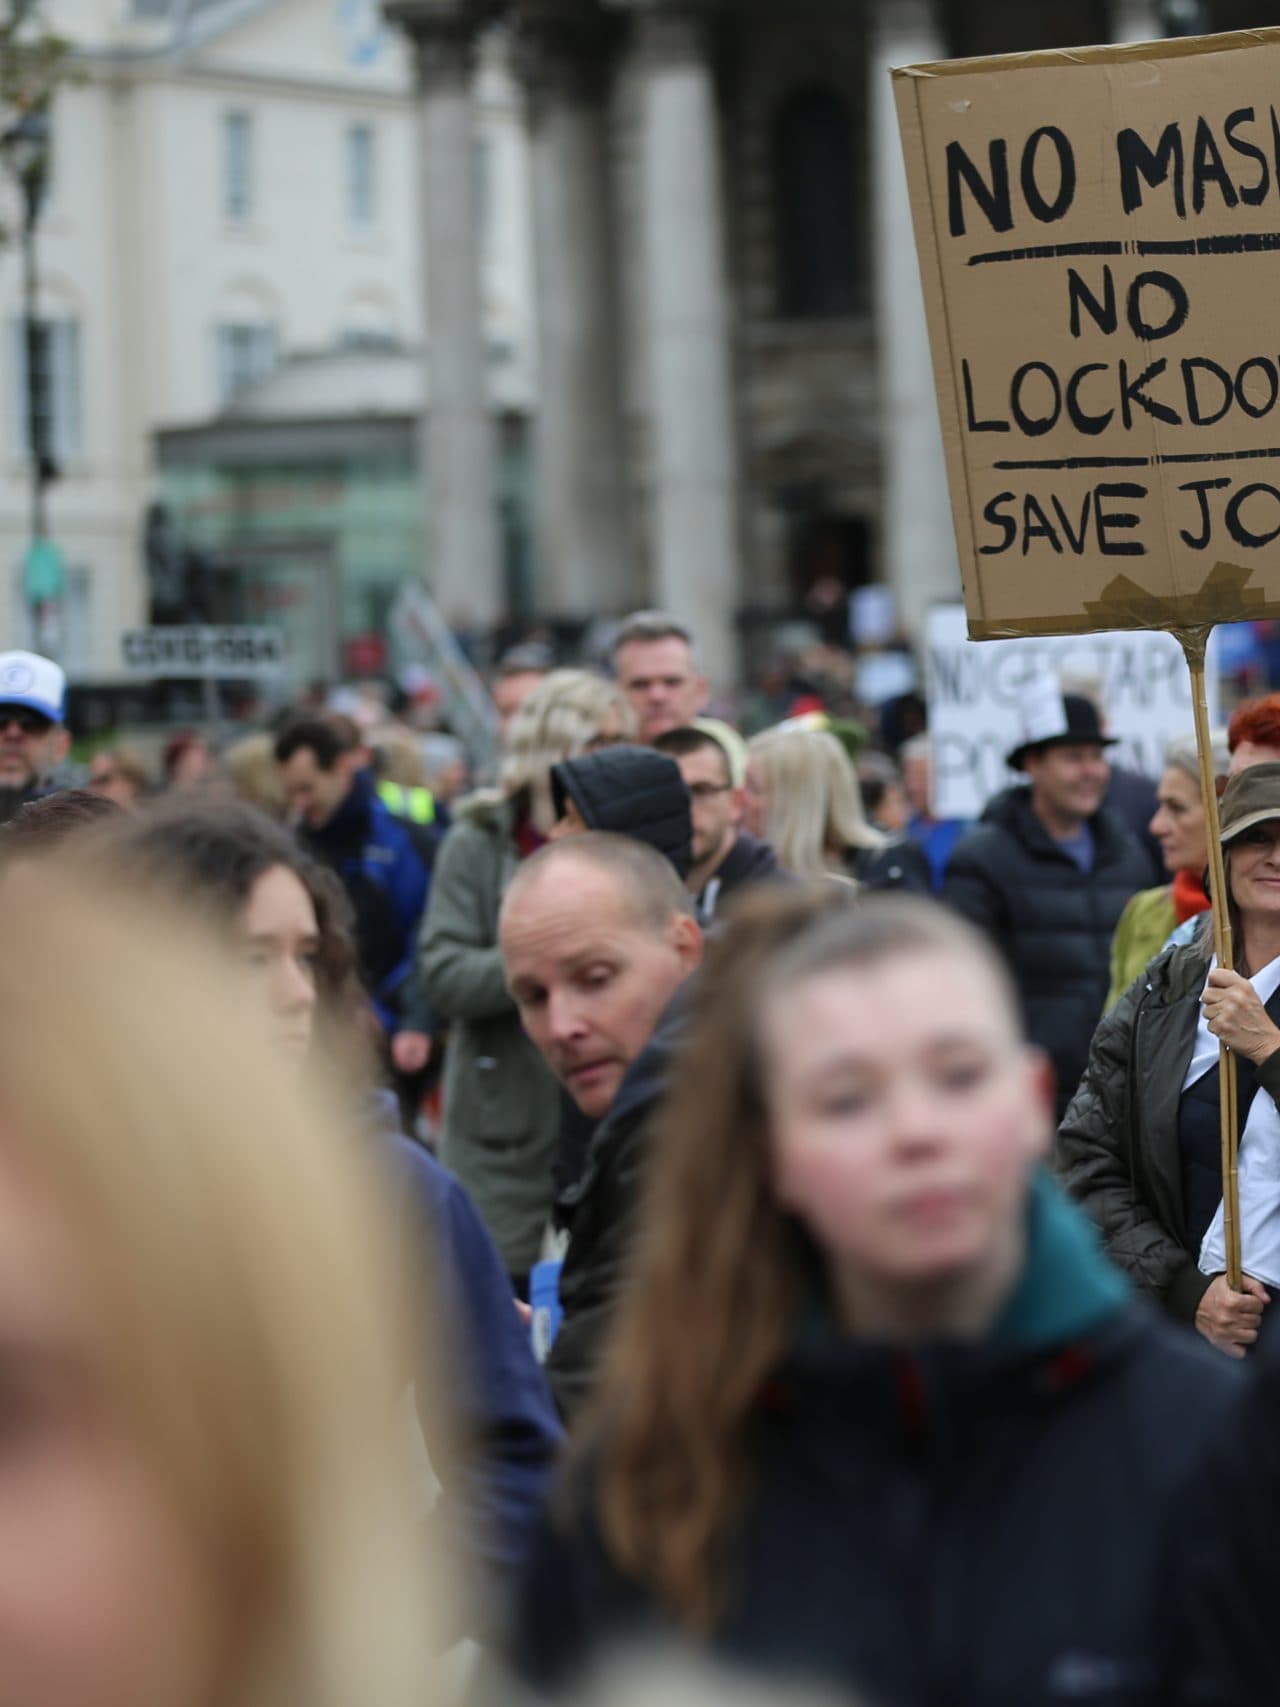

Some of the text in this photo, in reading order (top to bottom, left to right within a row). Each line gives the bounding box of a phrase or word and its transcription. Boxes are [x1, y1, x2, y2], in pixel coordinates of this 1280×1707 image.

[946, 126, 1076, 237] NO
[1068, 264, 1190, 341] NO
[979, 482, 1149, 556] SAVE
